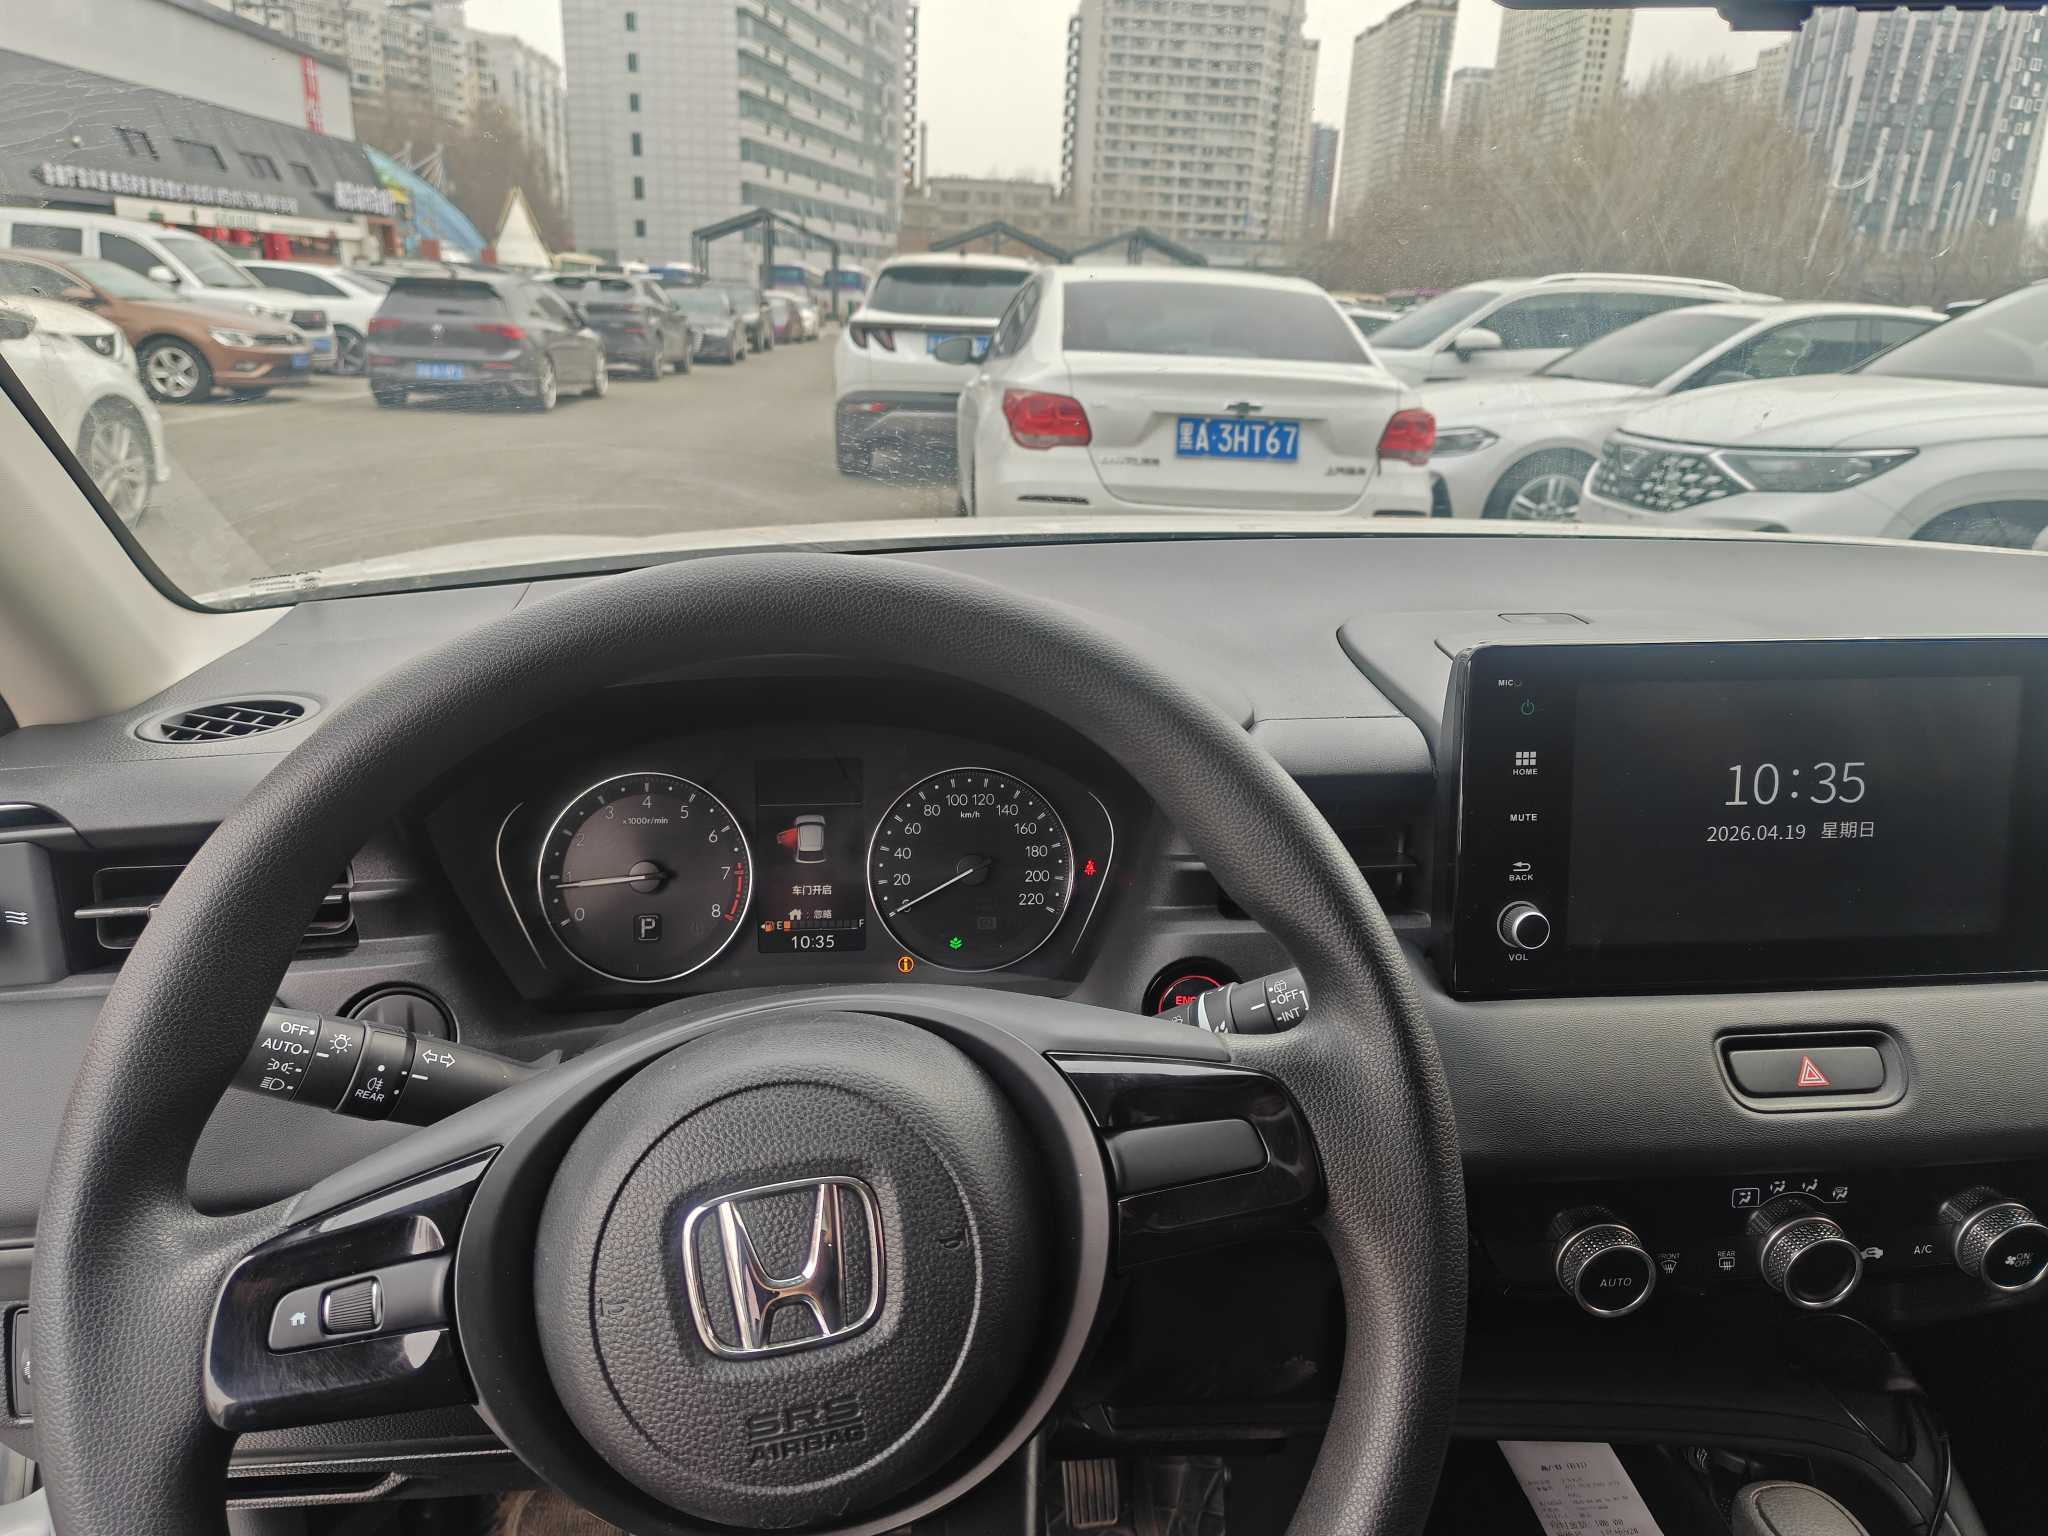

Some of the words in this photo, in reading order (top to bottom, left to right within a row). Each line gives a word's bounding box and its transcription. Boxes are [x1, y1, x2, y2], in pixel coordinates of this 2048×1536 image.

[1498, 679, 1514, 687] MIC
[1512, 768, 1538, 776] HOME
[1725, 762, 1865, 806] 10:35
[642, 796, 652, 809] 4
[946, 794, 968, 807] 100
[972, 793, 995, 806] 120
[605, 806, 615, 820] 3
[680, 805, 689, 819] 5
[923, 804, 941, 817] 80
[960, 811, 981, 820] km/h
[996, 804, 1019, 816] 140
[1509, 814, 1538, 822] MUTE
[904, 823, 922, 835] 60
[1014, 823, 1037, 836] 160
[1706, 824, 1806, 842] 2026.04.19
[1821, 821, 1874, 839] 星期日
[576, 832, 585, 847] 2
[708, 830, 719, 844] 6
[894, 847, 912, 860] 40
[1025, 845, 1048, 858] 180
[720, 866, 731, 881] 7
[893, 873, 911, 886] 20
[1025, 870, 1050, 883] 200
[1508, 874, 1534, 882] BACK
[791, 885, 832, 896] 车门开启
[1019, 893, 1044, 906] 220
[575, 908, 585, 921] 0
[711, 904, 721, 918] 8
[791, 935, 835, 949] 10:35
[1508, 953, 1529, 961] VOL
[1277, 989, 1299, 1005] OFF
[1282, 1007, 1301, 1022] INT
[280, 1022, 309, 1036] OFF
[261, 1037, 303, 1055] AUTO
[354, 1089, 385, 1103] REAR
[1717, 1250, 1736, 1258] REAR
[1914, 1243, 1933, 1255] A/C
[1600, 1277, 1632, 1288] AUTO
